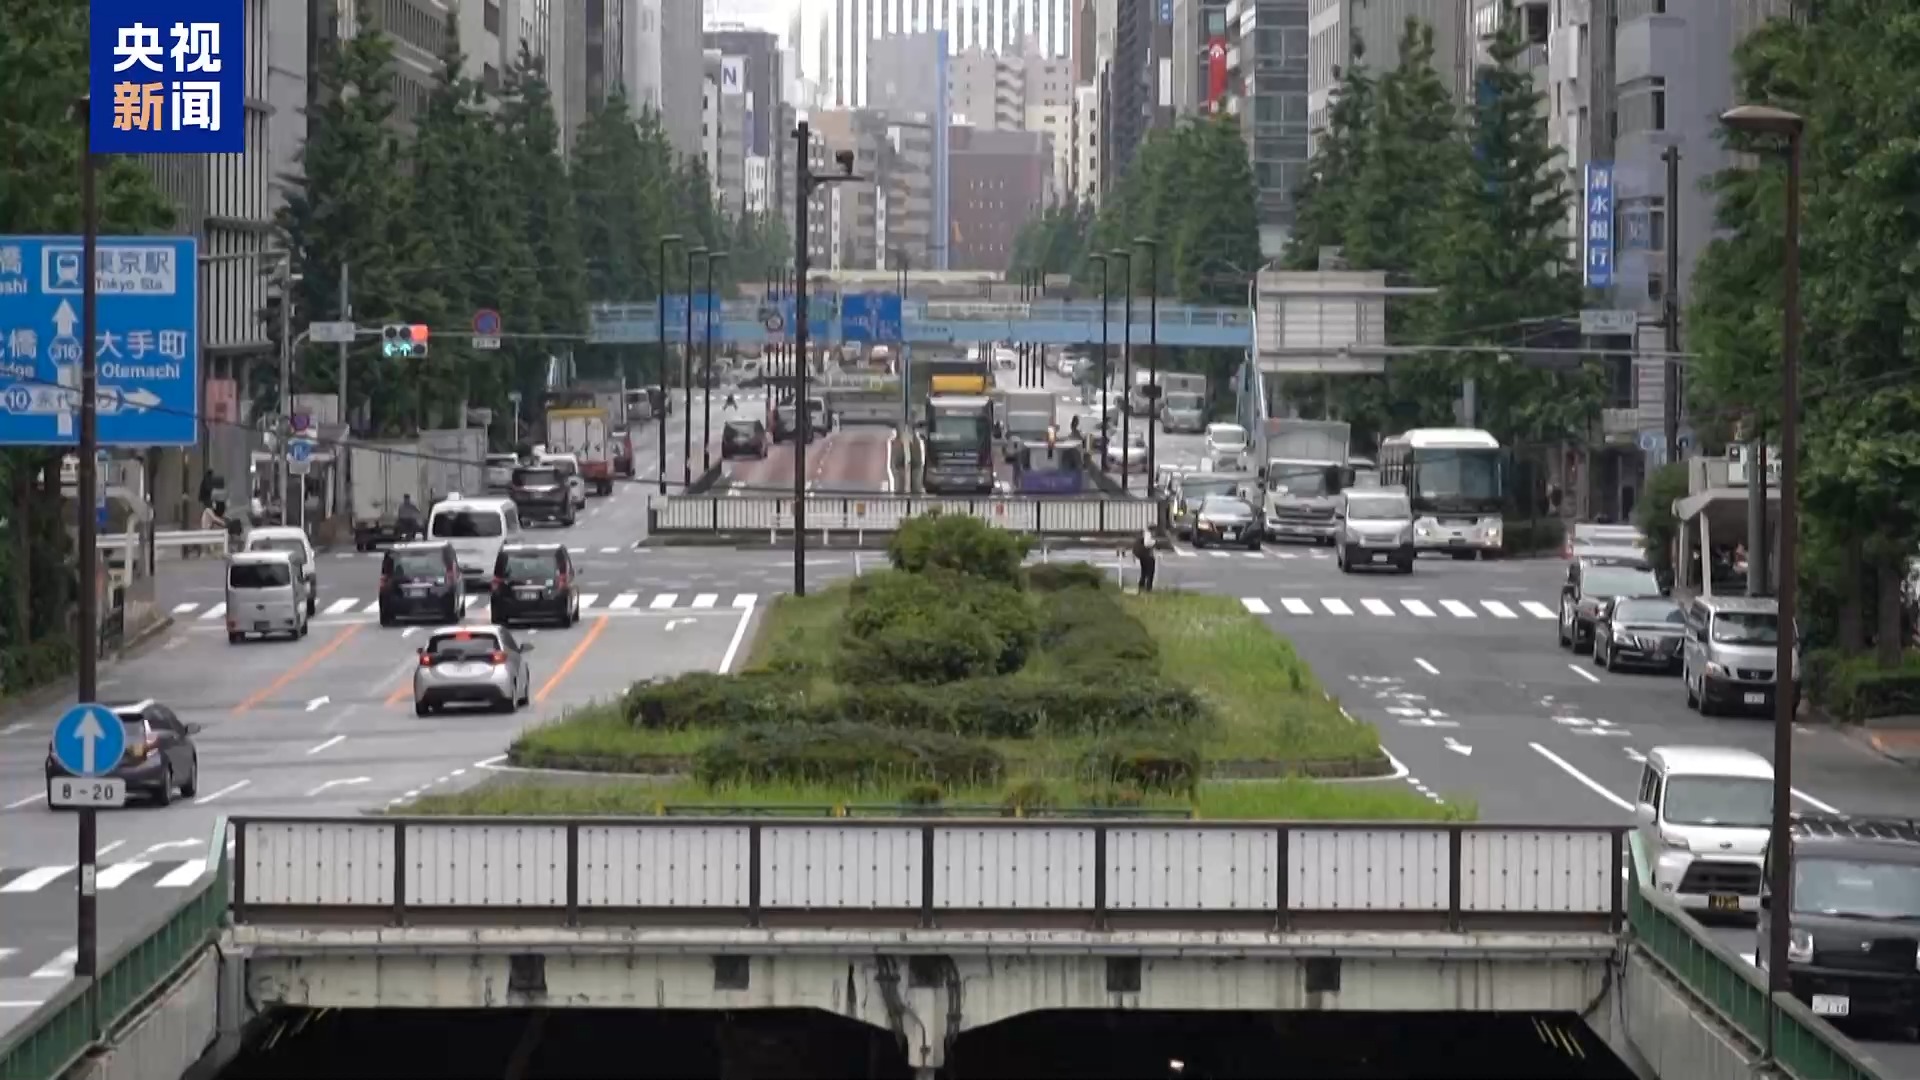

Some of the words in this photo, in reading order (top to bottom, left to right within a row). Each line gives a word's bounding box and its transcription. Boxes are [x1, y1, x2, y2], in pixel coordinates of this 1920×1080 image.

[723, 66, 737, 86] N
[1590, 168, 1608, 266] 清水銀行
[95, 251, 169, 275] 東京駅
[95, 278, 135, 292] Tokyo
[54, 343, 78, 360] 316
[95, 330, 187, 360] 大手町
[102, 362, 181, 379] Otemachi
[11, 391, 28, 409] 10
